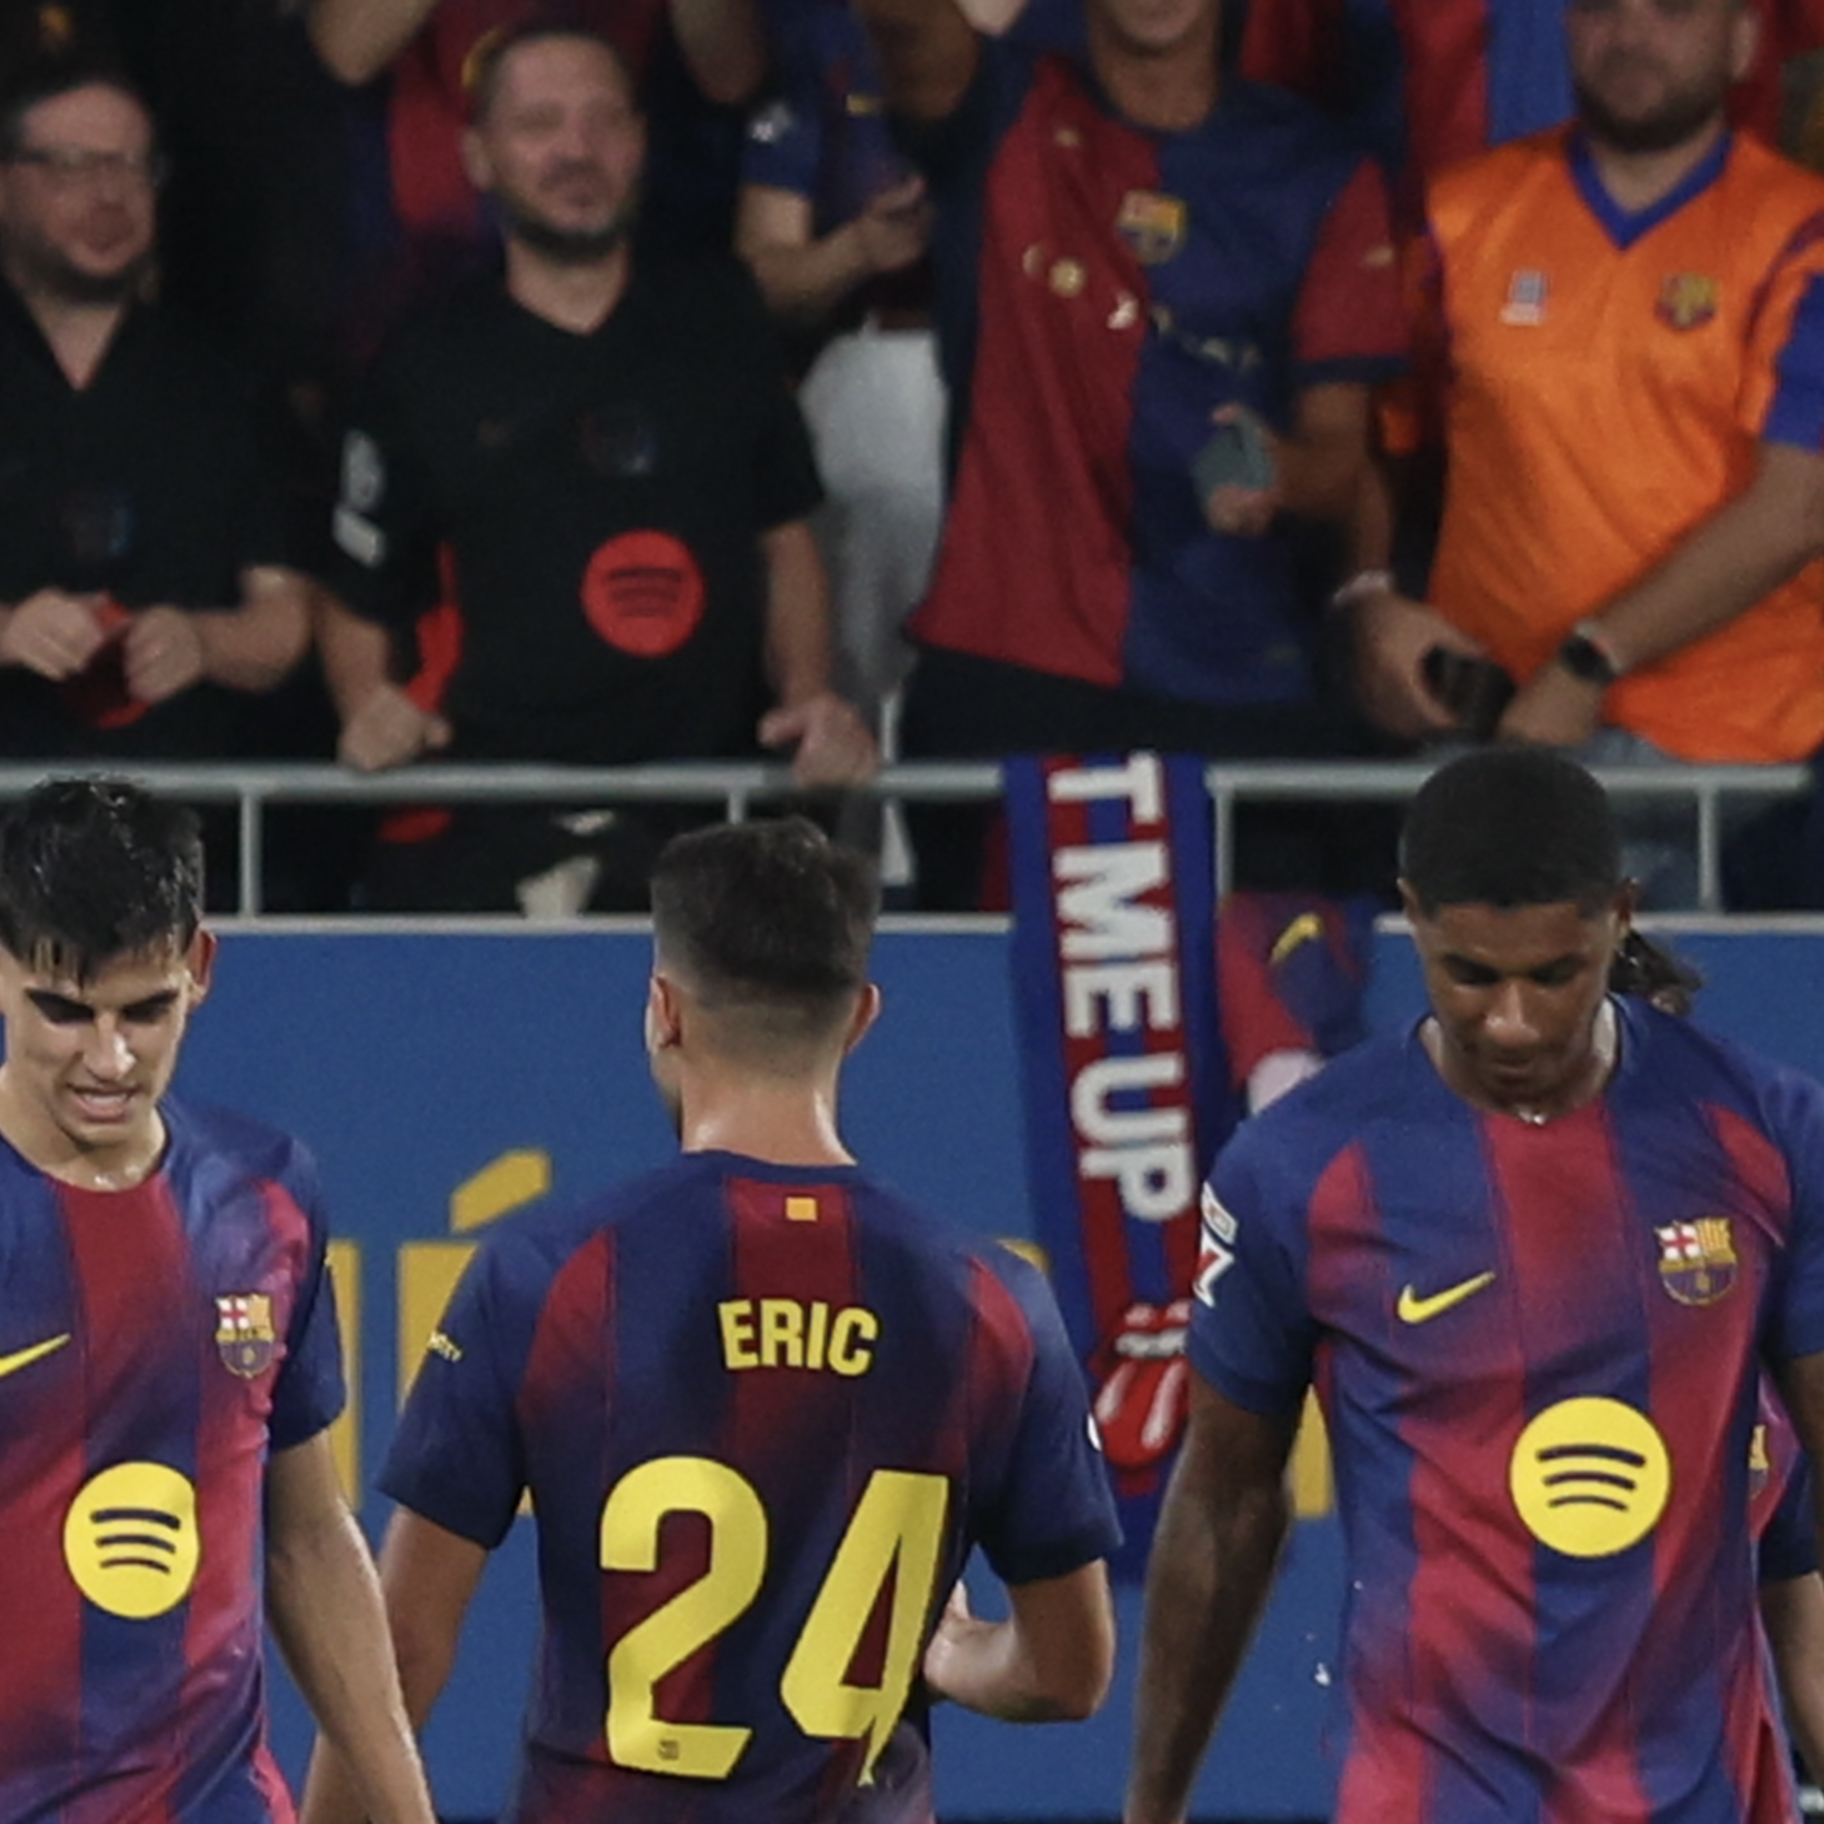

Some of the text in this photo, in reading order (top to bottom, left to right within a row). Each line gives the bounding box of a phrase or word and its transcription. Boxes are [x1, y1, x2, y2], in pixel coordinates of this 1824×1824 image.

[1052, 838, 1180, 1040] ME
[1070, 1050, 1197, 1223] UP
[717, 1298, 879, 1378] ERIC
[599, 1455, 949, 1786] 24
